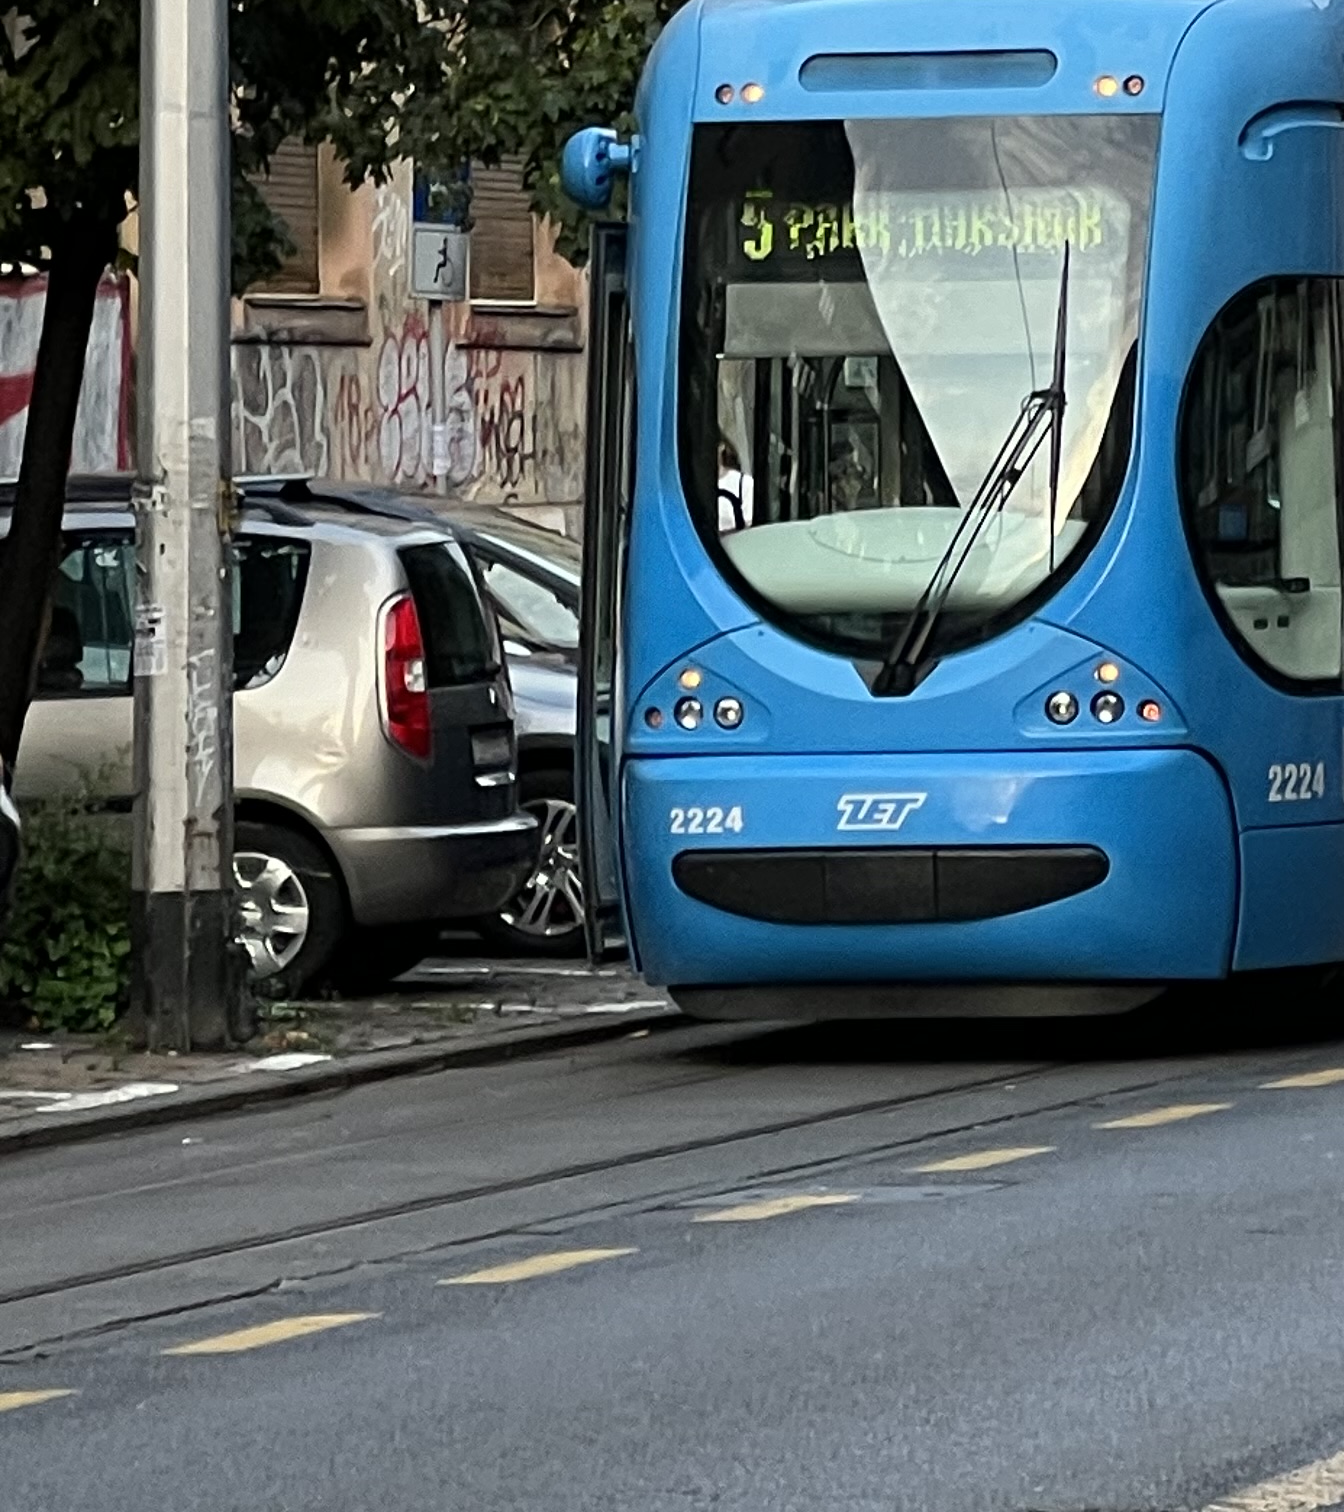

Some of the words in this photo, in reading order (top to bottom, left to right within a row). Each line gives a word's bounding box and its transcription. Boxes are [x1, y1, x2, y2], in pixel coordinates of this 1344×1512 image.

[740, 191, 774, 261] 5
[1266, 760, 1327, 804] 2224
[668, 804, 745, 836] 2224
[835, 791, 929, 832] ZET
